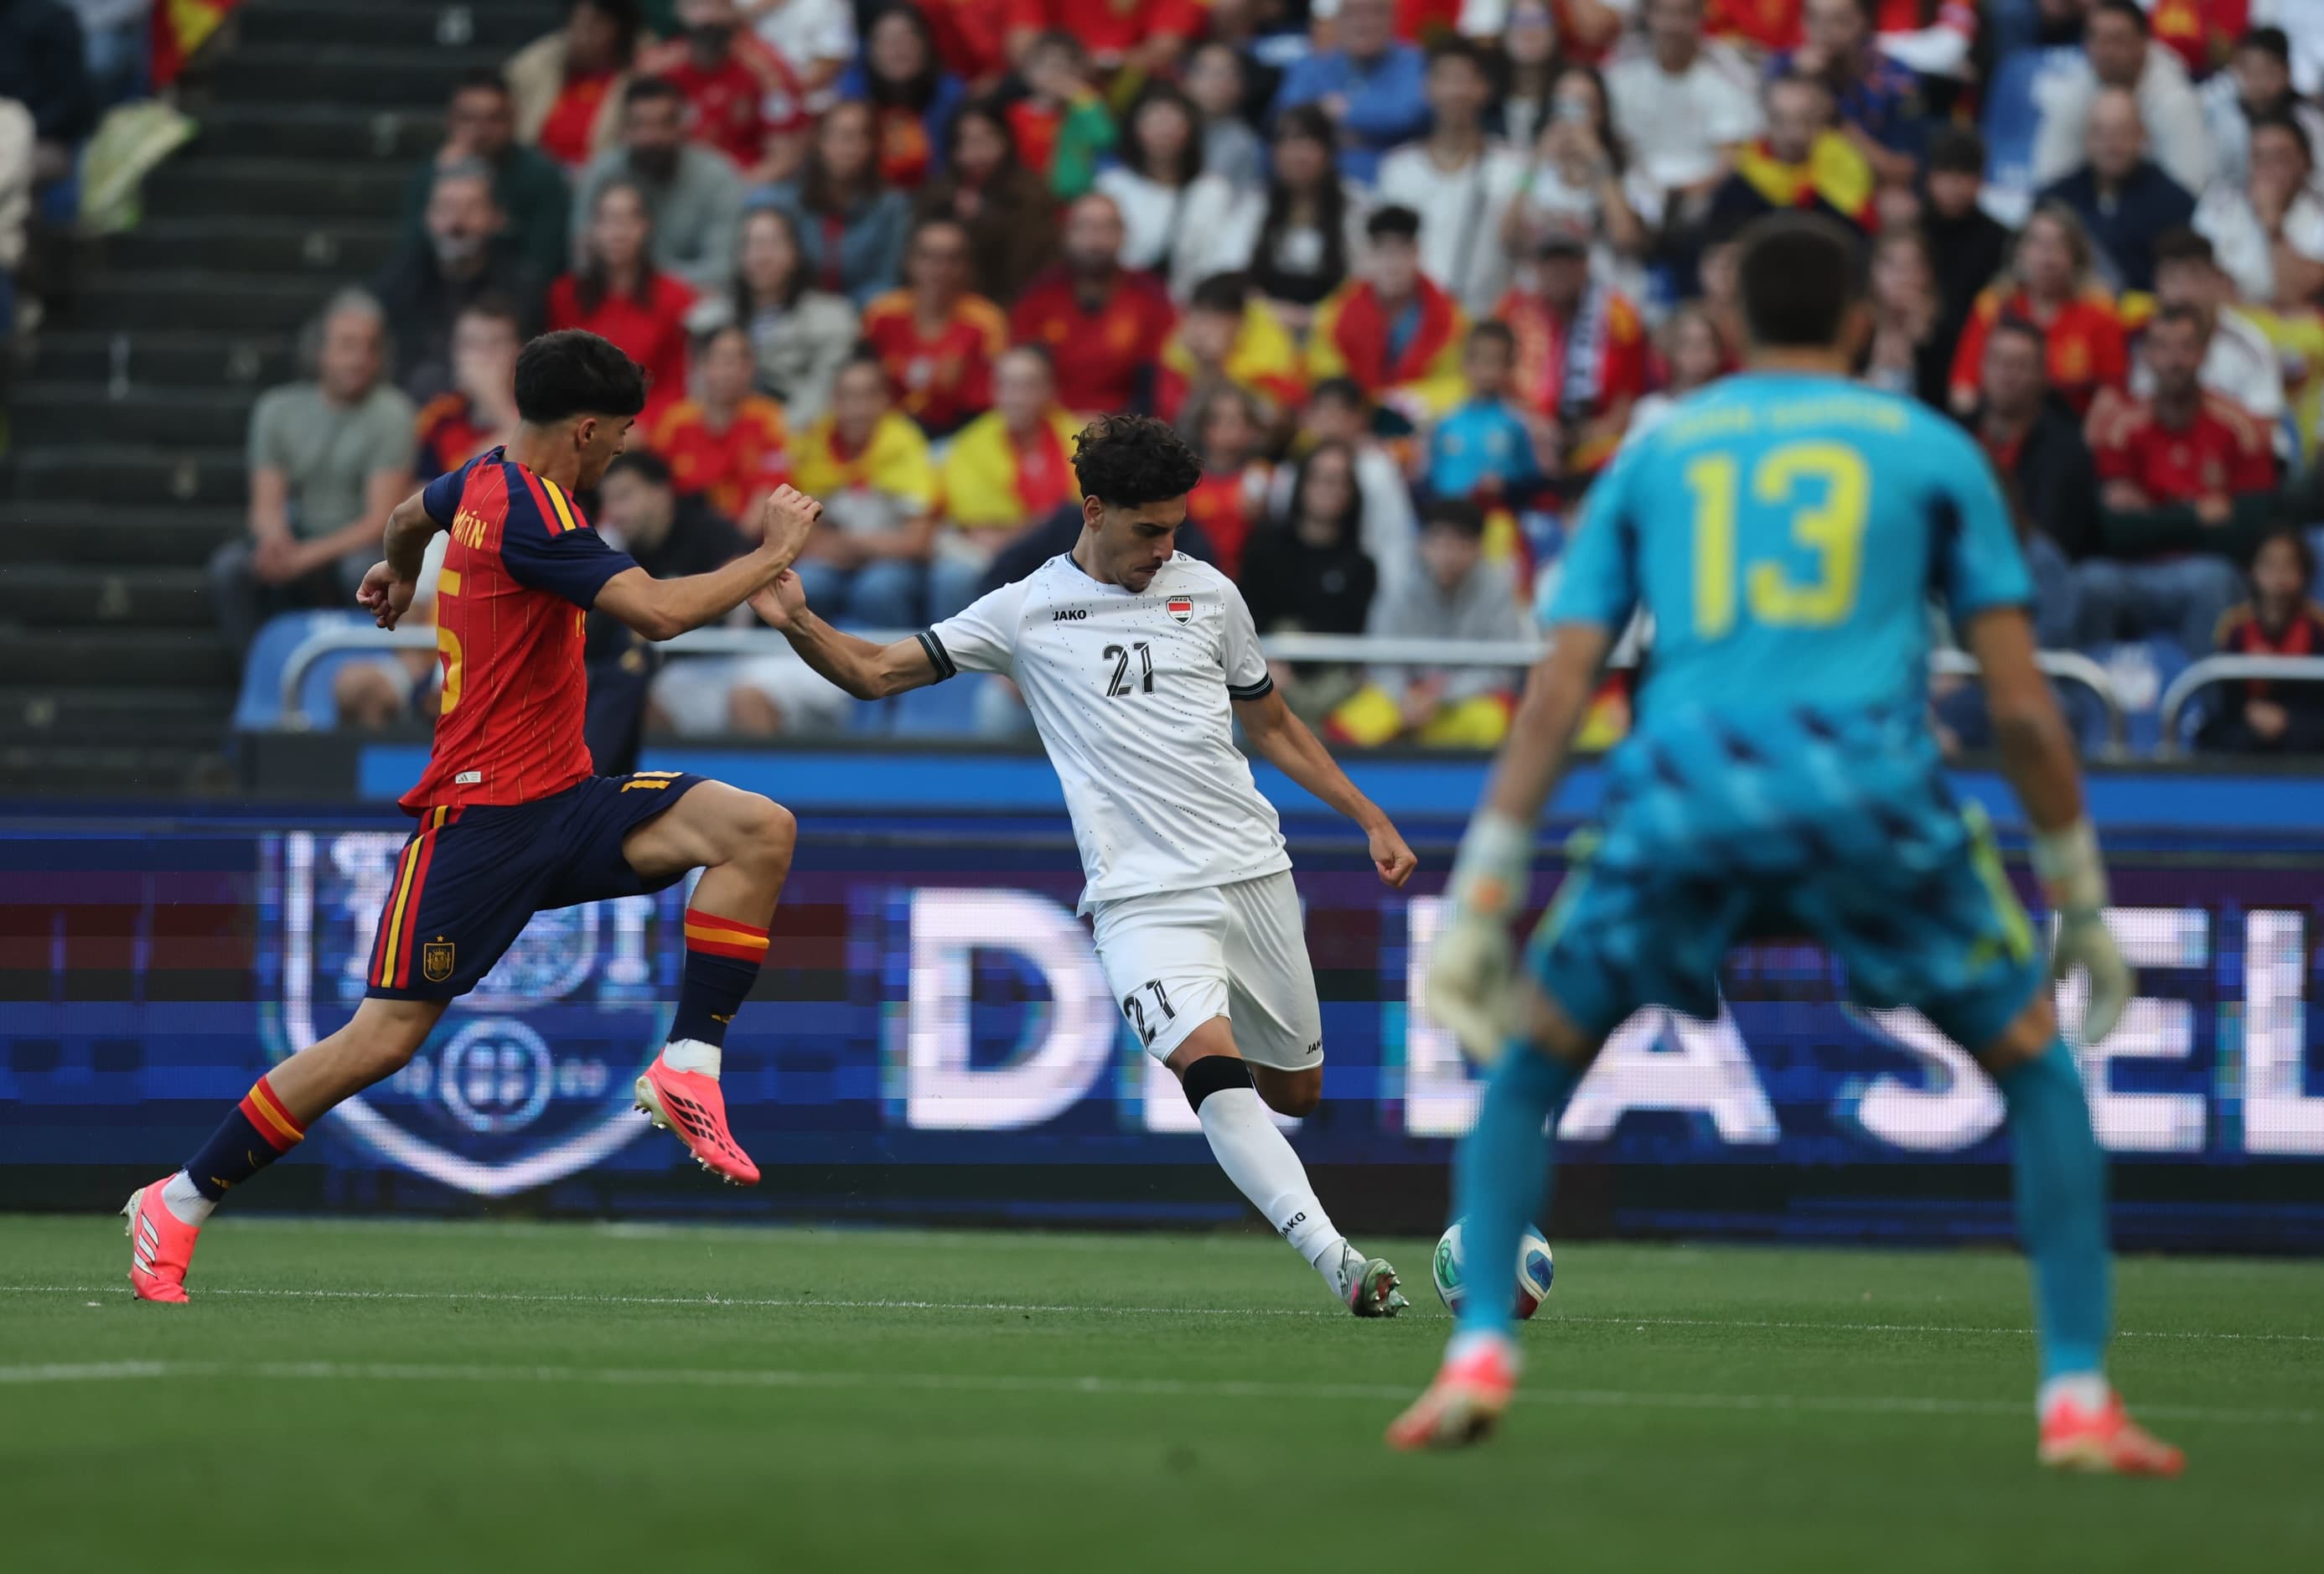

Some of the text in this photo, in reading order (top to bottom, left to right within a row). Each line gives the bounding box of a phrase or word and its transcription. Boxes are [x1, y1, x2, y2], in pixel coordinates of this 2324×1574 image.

[1683, 446, 1871, 637] 13
[1053, 609, 1087, 621] JAKO
[1102, 642, 1155, 697] 21
[1122, 978, 1178, 1050] 21
[1306, 1038, 1322, 1054] JAK
[1280, 1212, 1307, 1240] JAKO
